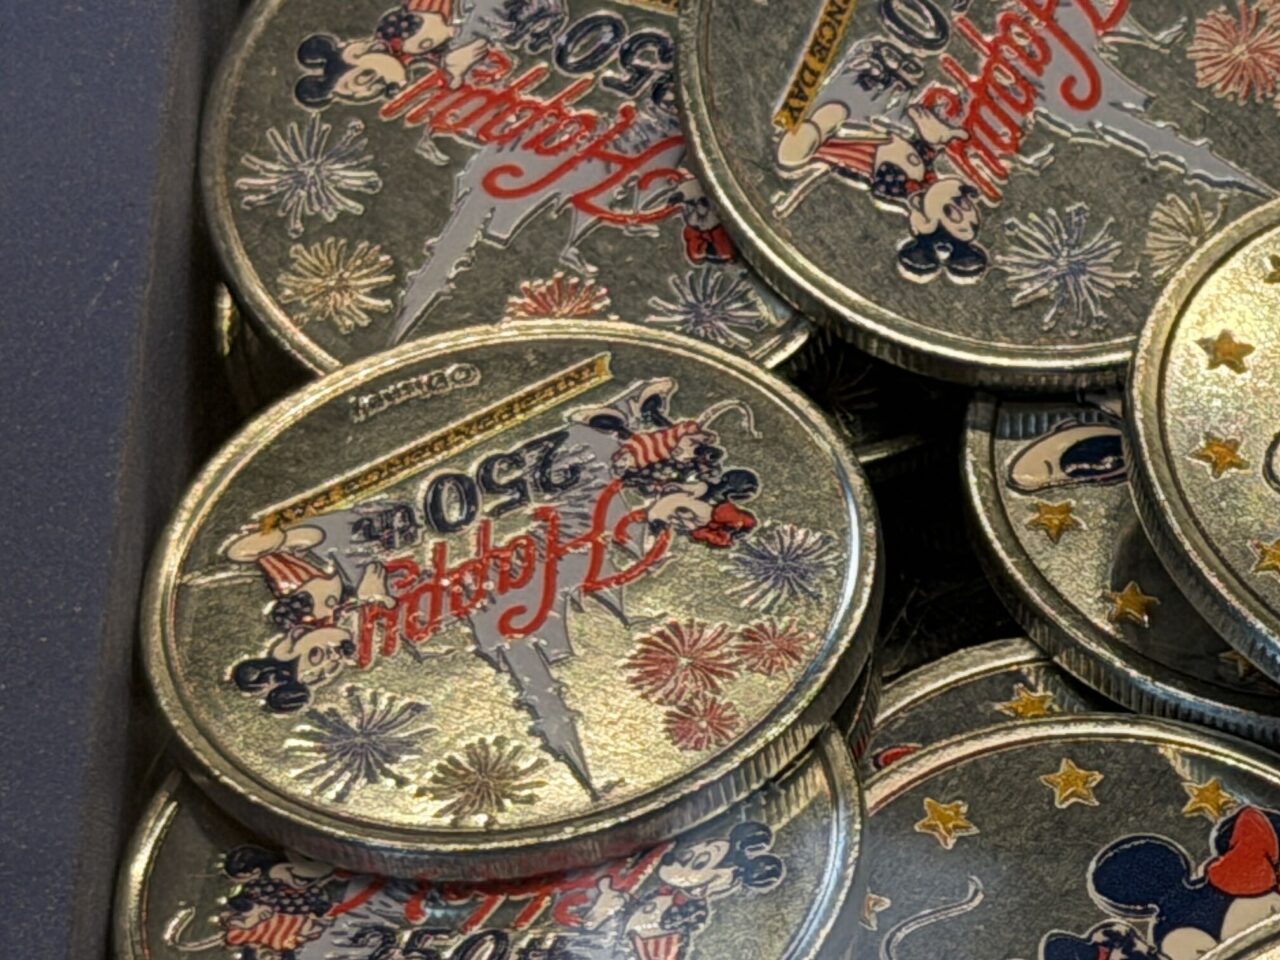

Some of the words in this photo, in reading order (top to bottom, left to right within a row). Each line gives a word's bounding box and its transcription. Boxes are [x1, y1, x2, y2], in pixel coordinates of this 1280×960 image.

[378, 48, 688, 225] Happy
[781, 60, 822, 124] DAY
[350, 428, 582, 550] 250th
[356, 478, 672, 670] Happy
